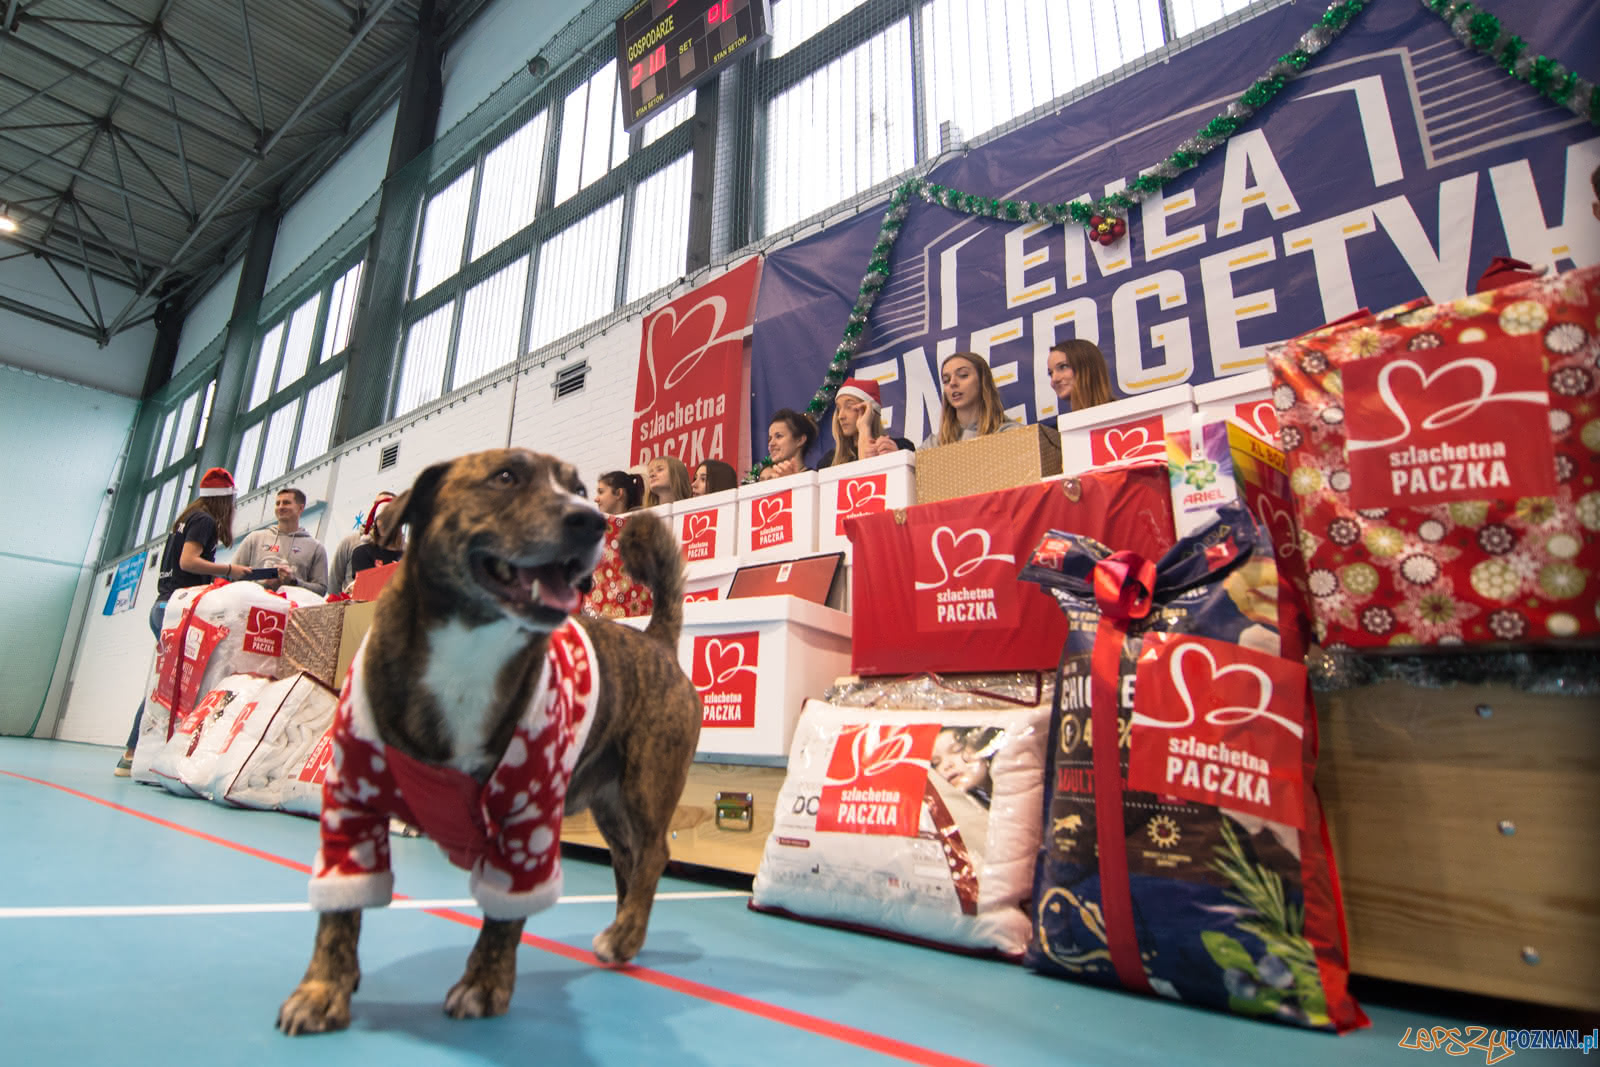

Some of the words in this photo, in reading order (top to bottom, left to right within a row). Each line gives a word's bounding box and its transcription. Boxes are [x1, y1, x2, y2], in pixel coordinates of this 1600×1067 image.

[628, 14, 675, 62] GOSPODARZE
[679, 37, 693, 55] SET
[1005, 128, 1300, 310] ENEA
[640, 393, 725, 442] szlachetna
[639, 423, 724, 467] PCZKA
[1390, 441, 1506, 467] szlachetna
[1391, 460, 1511, 496] PACZKA
[1183, 488, 1225, 505] ARIEL
[760, 531, 785, 545] PACZKA
[687, 547, 709, 559] PACZKA
[936, 586, 995, 603] szlachetna
[937, 600, 998, 623] PACZKA
[252, 641, 275, 653] PACZKA
[703, 704, 742, 721] PACZKA
[1168, 736, 1270, 775] szlachetna
[1165, 755, 1271, 806] PACZKA
[841, 787, 900, 803] szlachetna
[837, 803, 898, 826] PACZKA
